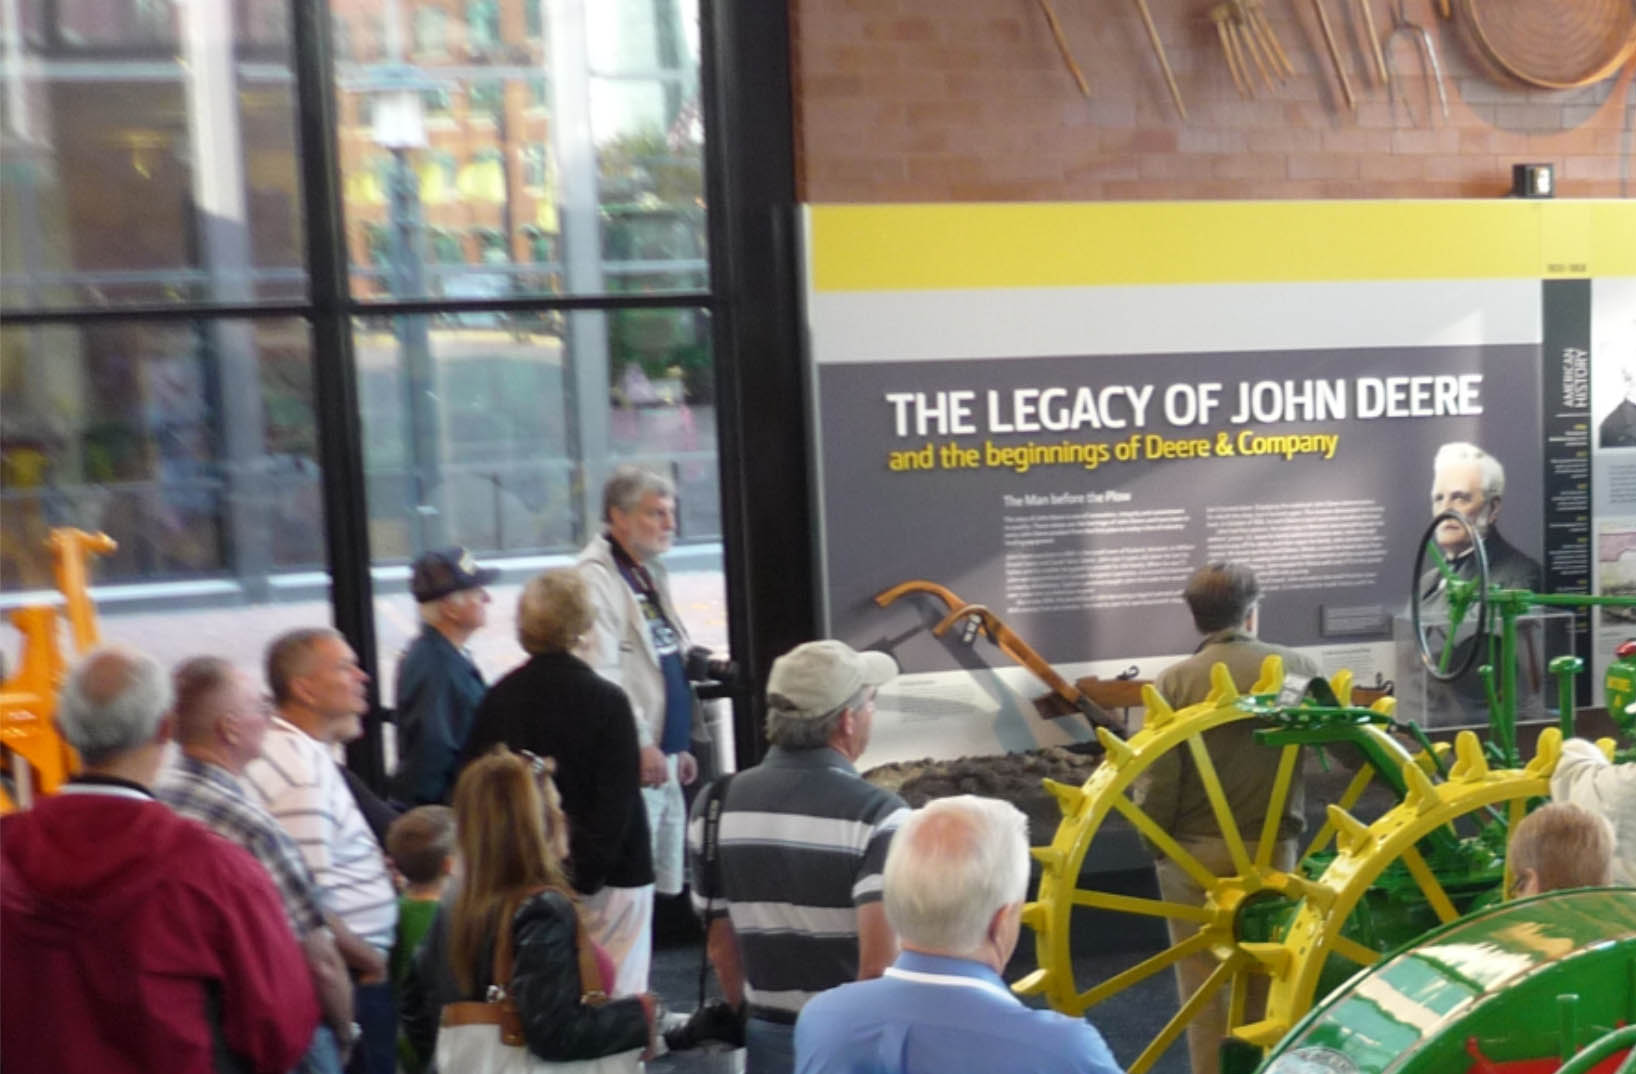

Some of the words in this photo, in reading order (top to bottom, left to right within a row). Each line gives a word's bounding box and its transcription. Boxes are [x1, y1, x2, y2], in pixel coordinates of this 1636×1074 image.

[886, 391, 977, 436] THE
[987, 385, 1154, 432] LEGACY
[1164, 382, 1222, 427] OF
[1230, 379, 1346, 424] JOHN
[1356, 374, 1484, 418] DEERE
[888, 444, 934, 471] and
[940, 442, 980, 468] the
[985, 440, 1110, 473] beginnings
[1115, 434, 1141, 461] of
[1145, 434, 1210, 459] Deere
[1215, 431, 1234, 457] &
[1237, 430, 1338, 459] Company
